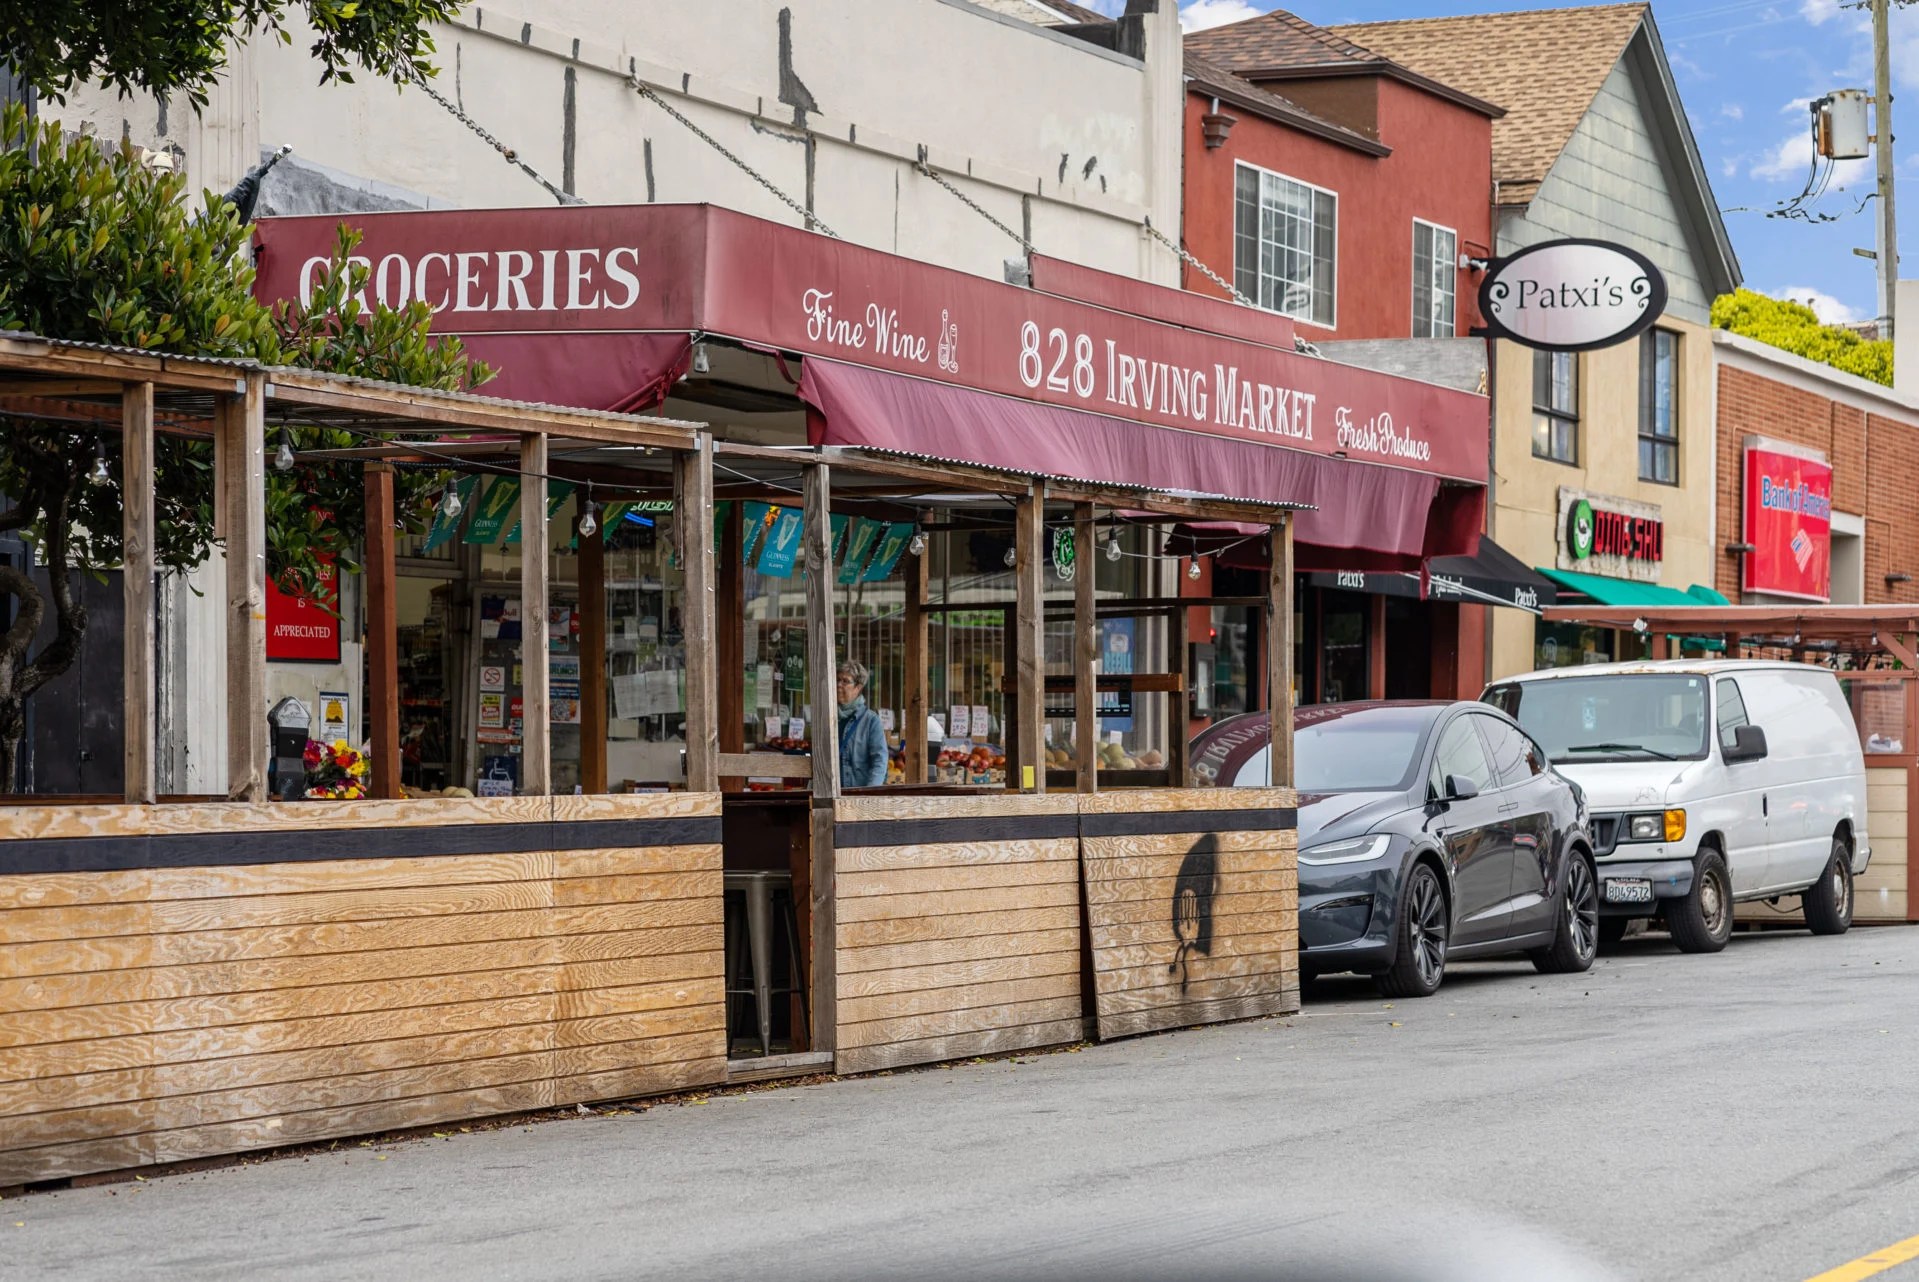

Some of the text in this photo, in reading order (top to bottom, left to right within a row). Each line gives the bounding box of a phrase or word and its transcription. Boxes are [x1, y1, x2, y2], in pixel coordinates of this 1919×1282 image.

[1515, 276, 1623, 310] Patxi's
[803, 288, 930, 363] Fine Wine
[1019, 320, 1095, 398] 828
[1335, 406, 1431, 462] Fresh Produce
[1762, 475, 1792, 512] Bank
[1792, 481, 1802, 514] of
[273, 624, 331, 638] APPRECIATED
